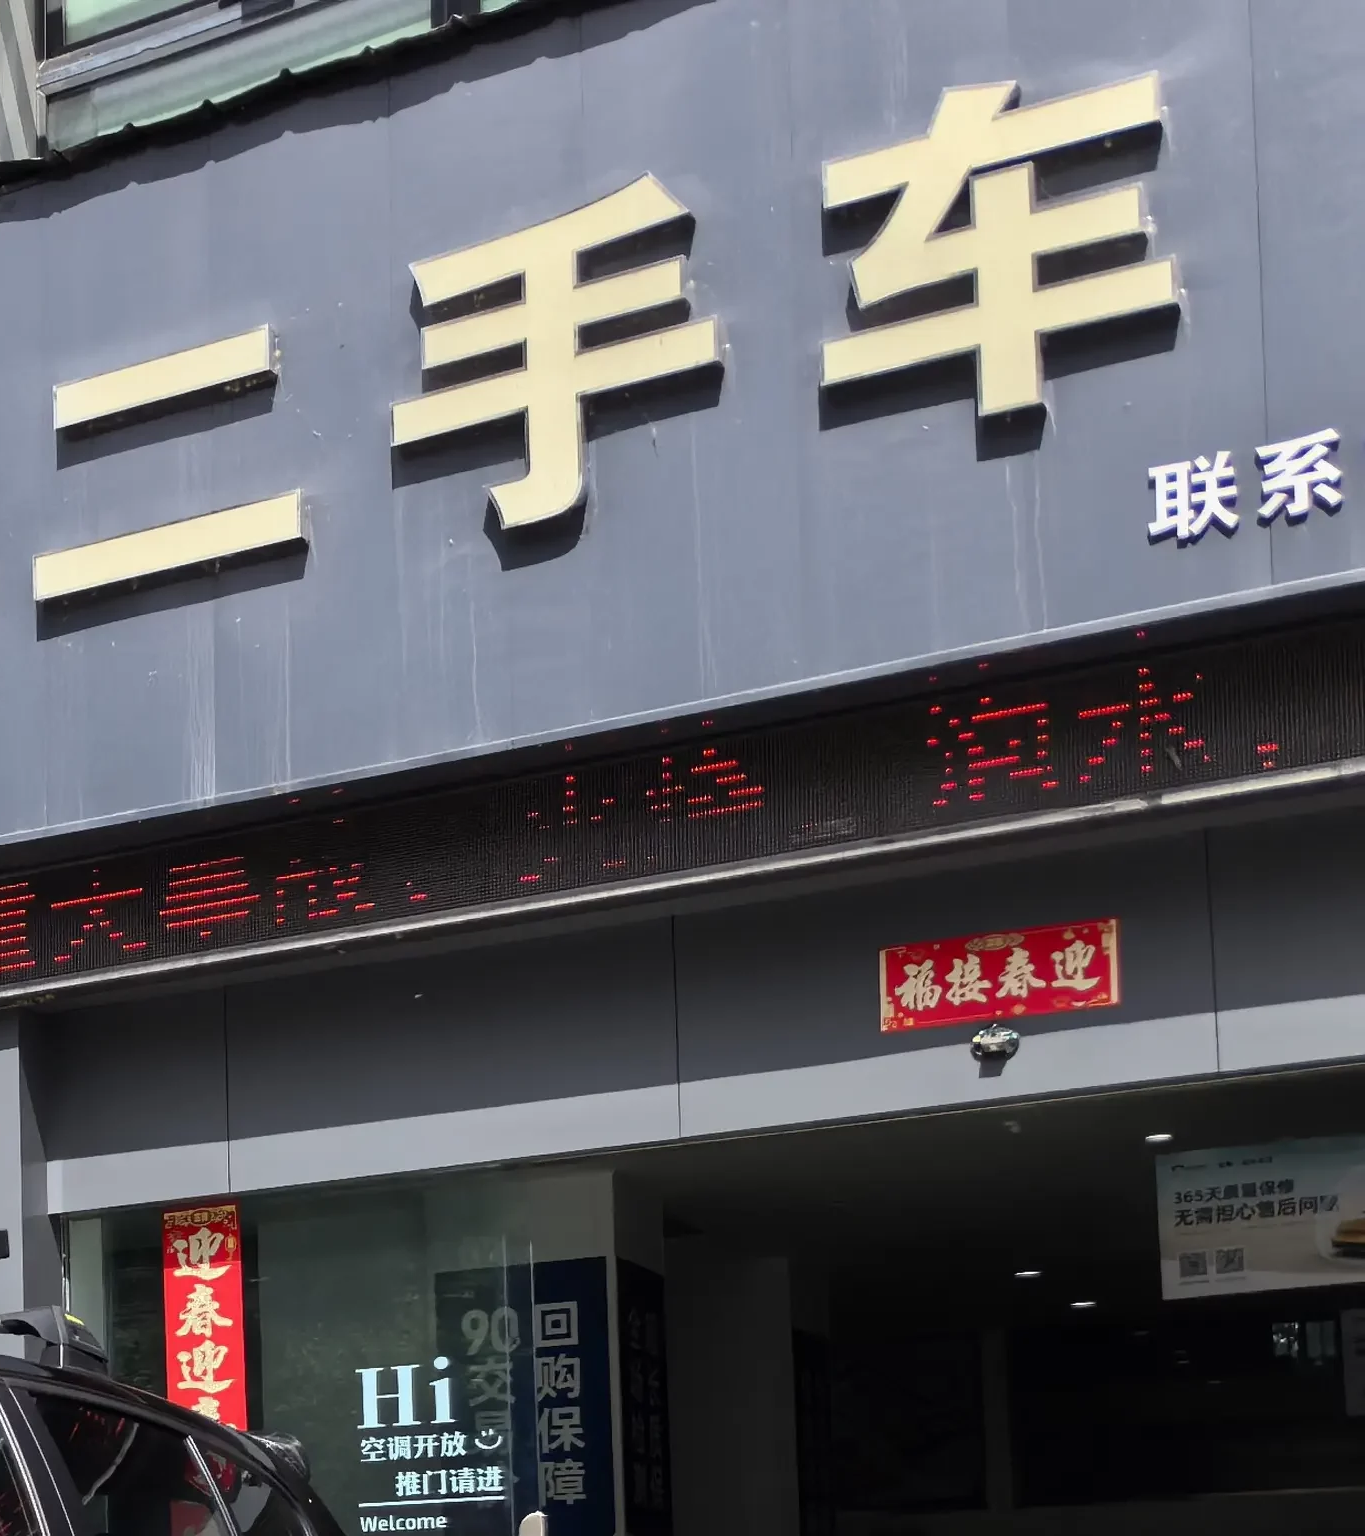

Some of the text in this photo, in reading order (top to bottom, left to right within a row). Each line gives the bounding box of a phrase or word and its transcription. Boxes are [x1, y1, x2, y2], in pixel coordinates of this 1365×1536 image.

[1146, 426, 1345, 544] 联系
[355, 1356, 458, 1430] Hi
[534, 1300, 588, 1507] 回购保障
[360, 1432, 467, 1463] 空调开放
[394, 1466, 505, 1498] 推门请进
[359, 1512, 448, 1534] Welcome
